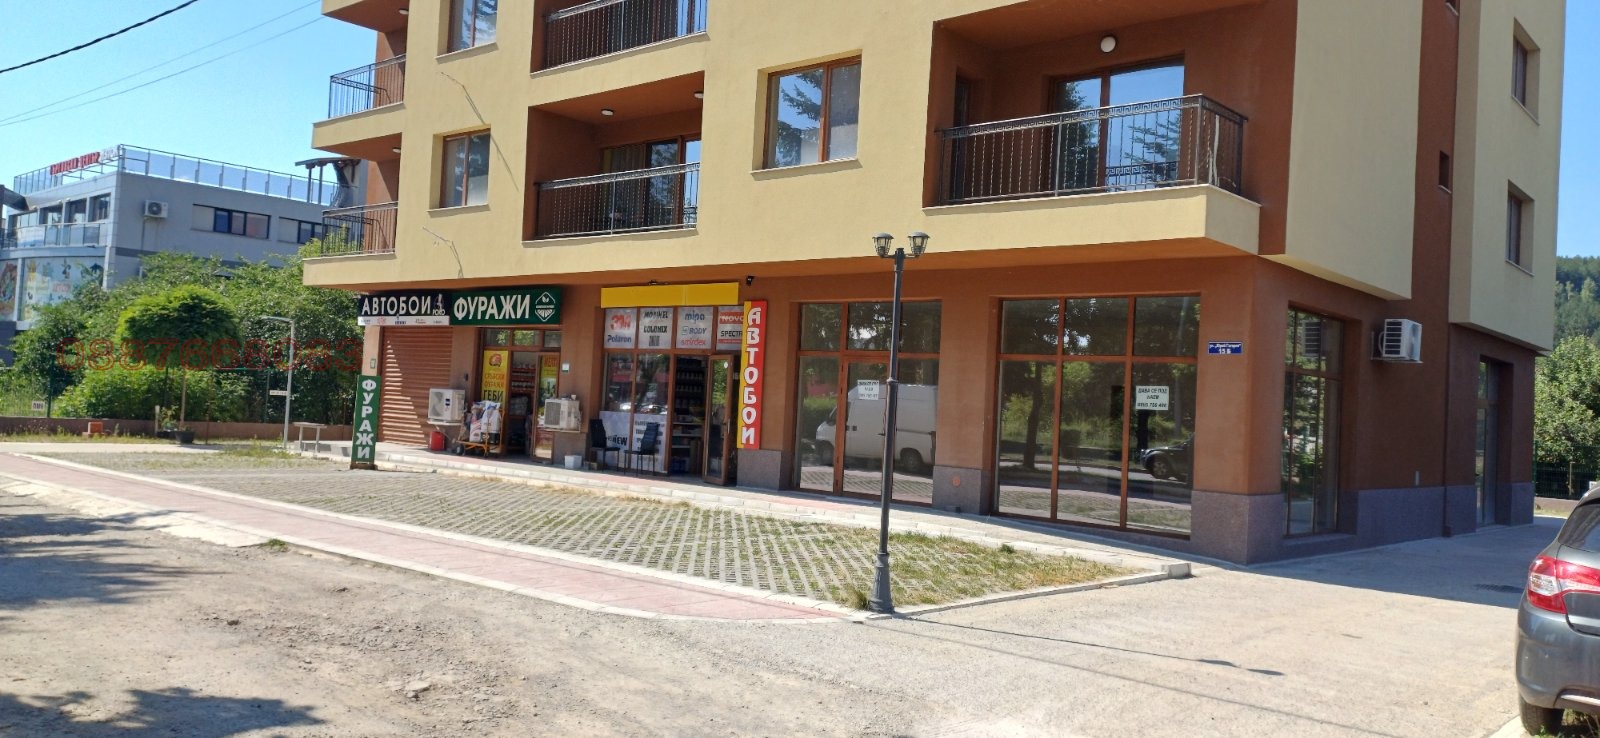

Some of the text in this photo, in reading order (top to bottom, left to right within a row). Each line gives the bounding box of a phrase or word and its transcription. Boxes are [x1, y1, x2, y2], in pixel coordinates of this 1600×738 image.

[361, 296, 432, 315] АВТОБОИ
[454, 295, 530, 320] ФУРАЖИ
[741, 307, 762, 445] АВТОБОИ
[483, 390, 503, 401] ГЕБИ
[355, 379, 377, 459] ФУРАЖИ
